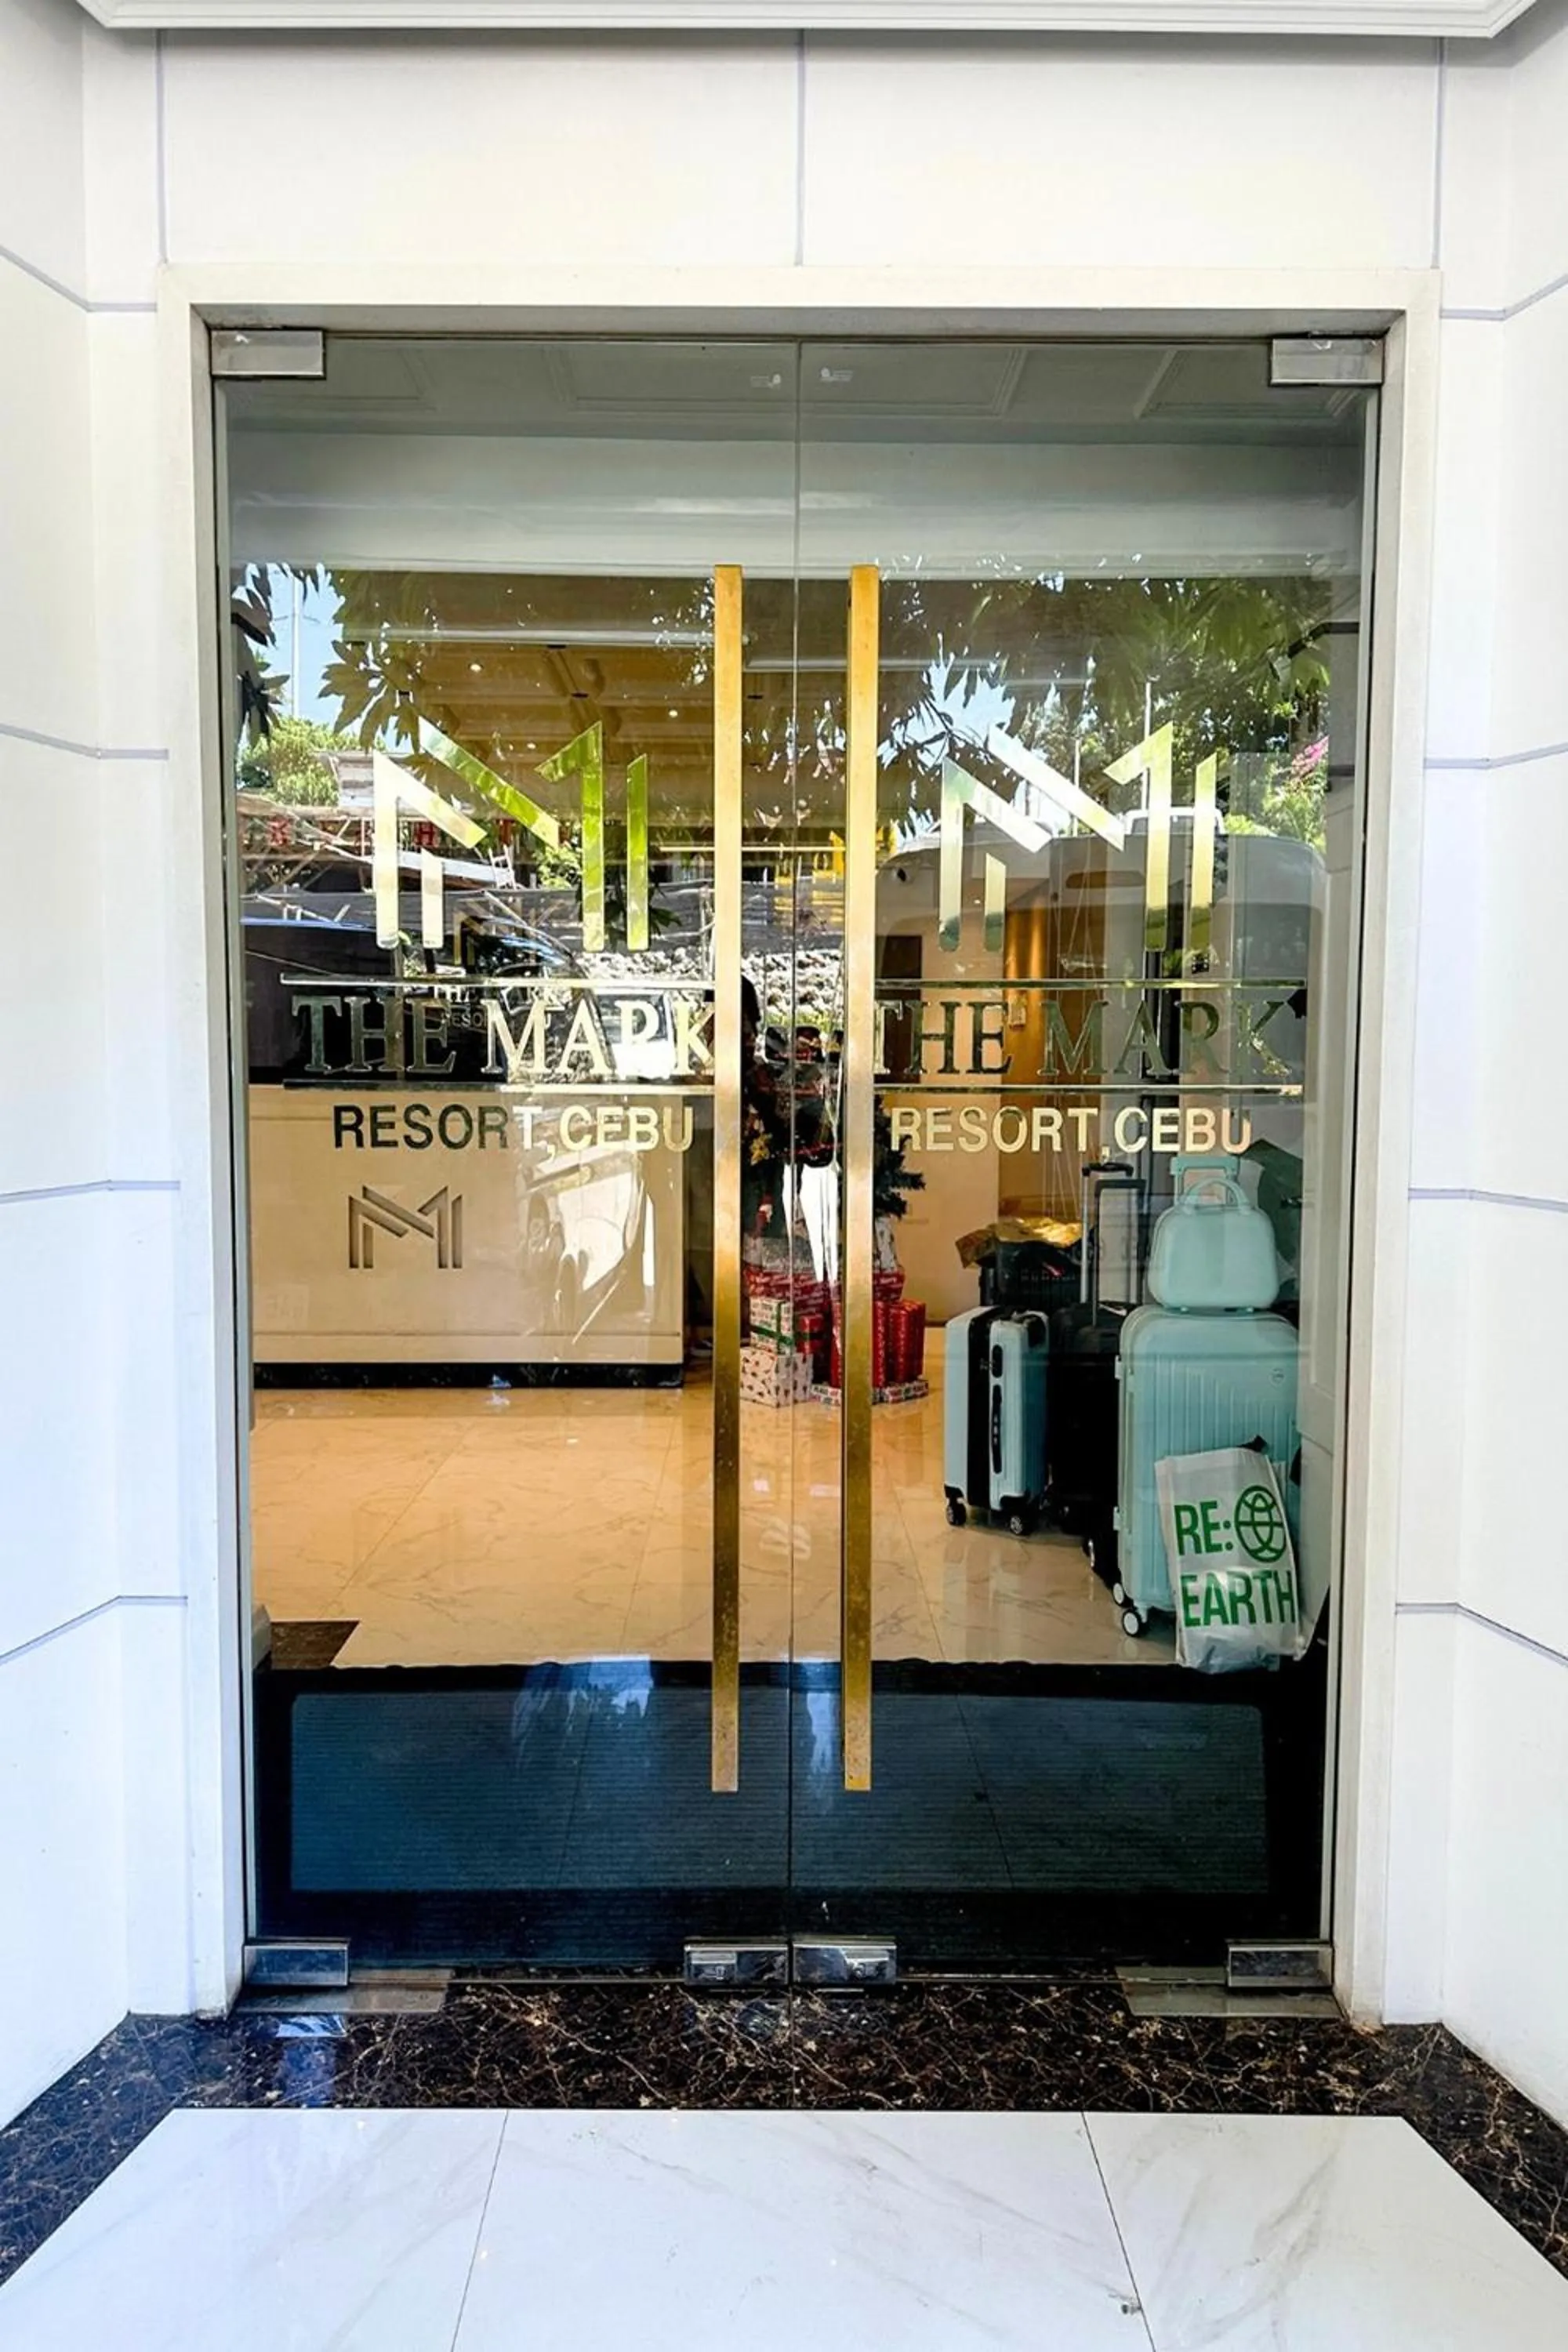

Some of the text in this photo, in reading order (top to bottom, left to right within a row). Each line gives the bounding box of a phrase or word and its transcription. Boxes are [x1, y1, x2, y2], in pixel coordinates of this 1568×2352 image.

[292, 996, 457, 1073] THE
[1036, 1000, 1292, 1076] MARK
[1174, 1501, 1233, 1555] RE:
[1181, 1570, 1295, 1627] EARTH
